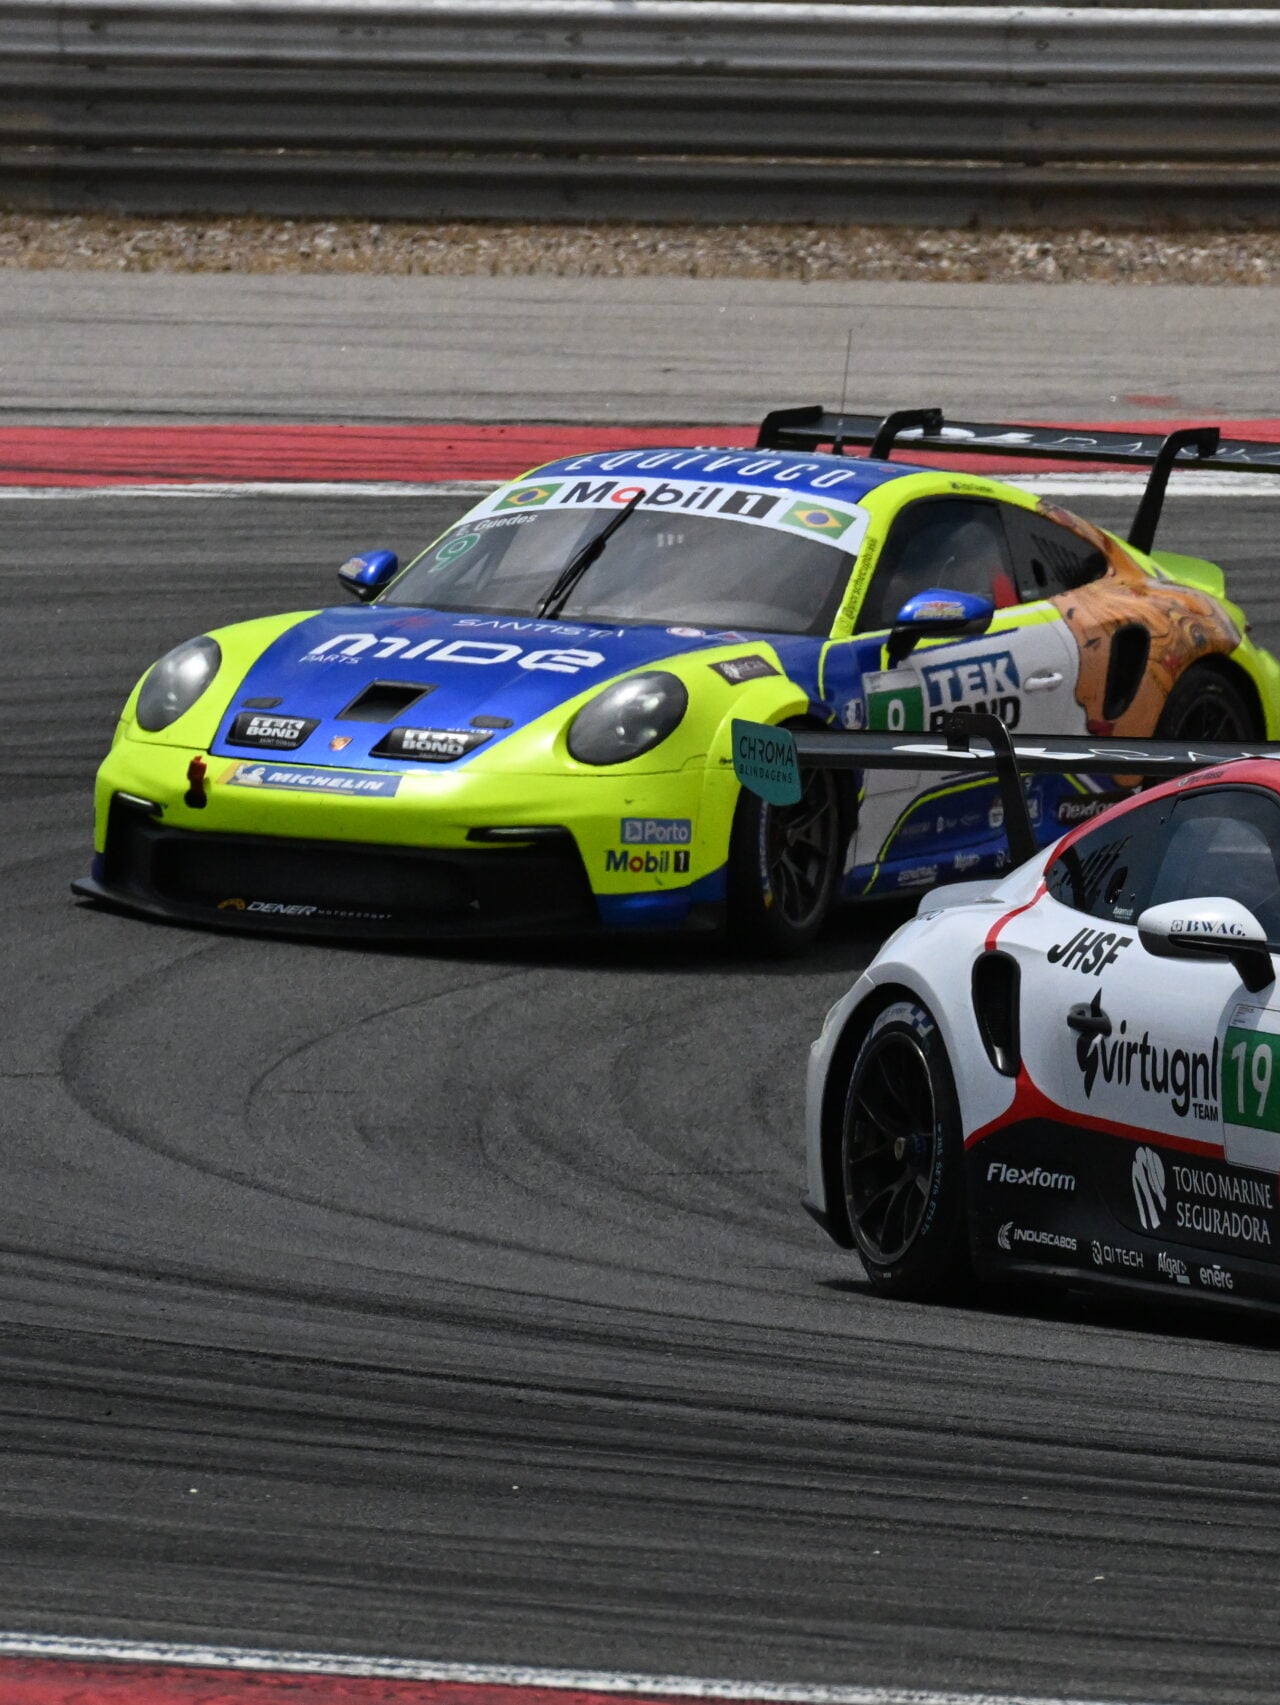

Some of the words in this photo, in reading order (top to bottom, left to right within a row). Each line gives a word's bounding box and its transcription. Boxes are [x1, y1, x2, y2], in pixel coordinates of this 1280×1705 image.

[564, 450, 857, 488] EQUIVOCO
[560, 480, 723, 509] Mobil
[473, 513, 539, 532] Guedes
[427, 532, 481, 574] 9
[298, 653, 364, 665] PARTS
[928, 657, 1012, 707] TEK
[246, 726, 299, 739] BOND
[401, 739, 465, 755] BOND
[738, 735, 794, 767] CHROMA
[267, 771, 385, 791] MICHELIN
[738, 765, 793, 784] BLINDAGENS
[644, 820, 689, 841] Porto
[604, 850, 670, 873] Mobil
[246, 901, 318, 916] DENER
[1046, 927, 1134, 978] JHSF
[1230, 1042, 1274, 1118] 19
[1192, 1102, 1220, 1122] TEAM
[986, 1162, 1076, 1191] Flexform
[1172, 1165, 1217, 1198] TOKIO
[1218, 1174, 1273, 1210] MARINE
[1176, 1202, 1272, 1245] SEGURADORA
